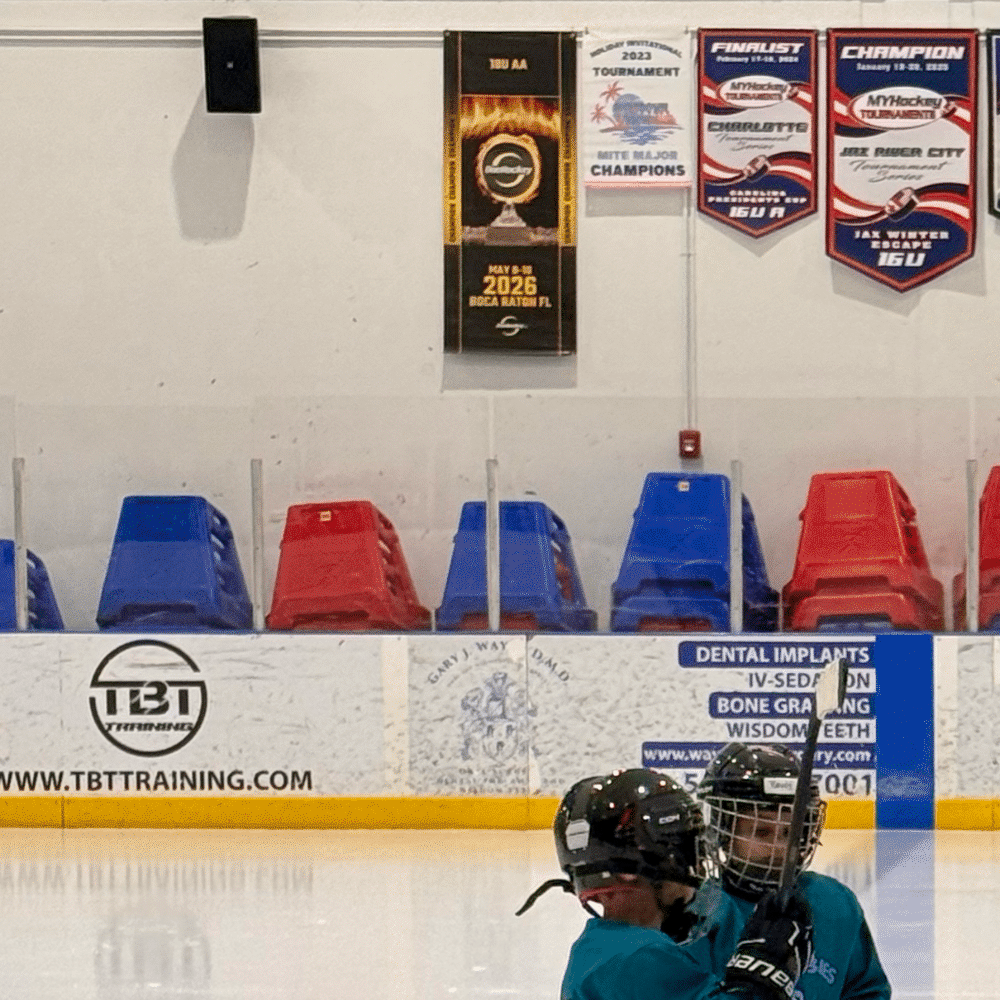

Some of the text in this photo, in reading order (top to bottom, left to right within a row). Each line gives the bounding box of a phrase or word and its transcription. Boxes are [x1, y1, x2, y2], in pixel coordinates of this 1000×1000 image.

[711, 42, 804, 54] FINALIST
[840, 46, 965, 59] CHAMPION
[592, 67, 680, 77] TOURNAMENT
[731, 81, 787, 94] MYHockey
[866, 95, 943, 109] MYHockey
[861, 109, 936, 119] TOURNAMENTS
[707, 121, 808, 133] CHARLOTTE
[874, 147, 922, 158] RIVER
[926, 147, 966, 158] CITY
[590, 164, 686, 176] CHAMPIONS
[848, 160, 950, 172] Tournament
[729, 206, 786, 218] 16U A
[854, 231, 949, 239] JAX WINTER
[870, 241, 932, 249] ESCAPE
[877, 252, 926, 267] 16U
[483, 275, 537, 295] 2026
[696, 647, 869, 663] DENTAL IMPLANTS
[427, 652, 459, 685] GARY
[103, 680, 192, 716] TBT
[717, 698, 870, 714] BONE GRANG
[105, 722, 194, 732] TRAINING
[726, 723, 870, 738] WISDOM EETH
[0, 770, 313, 791] WWW.TBTTRAINING.COM
